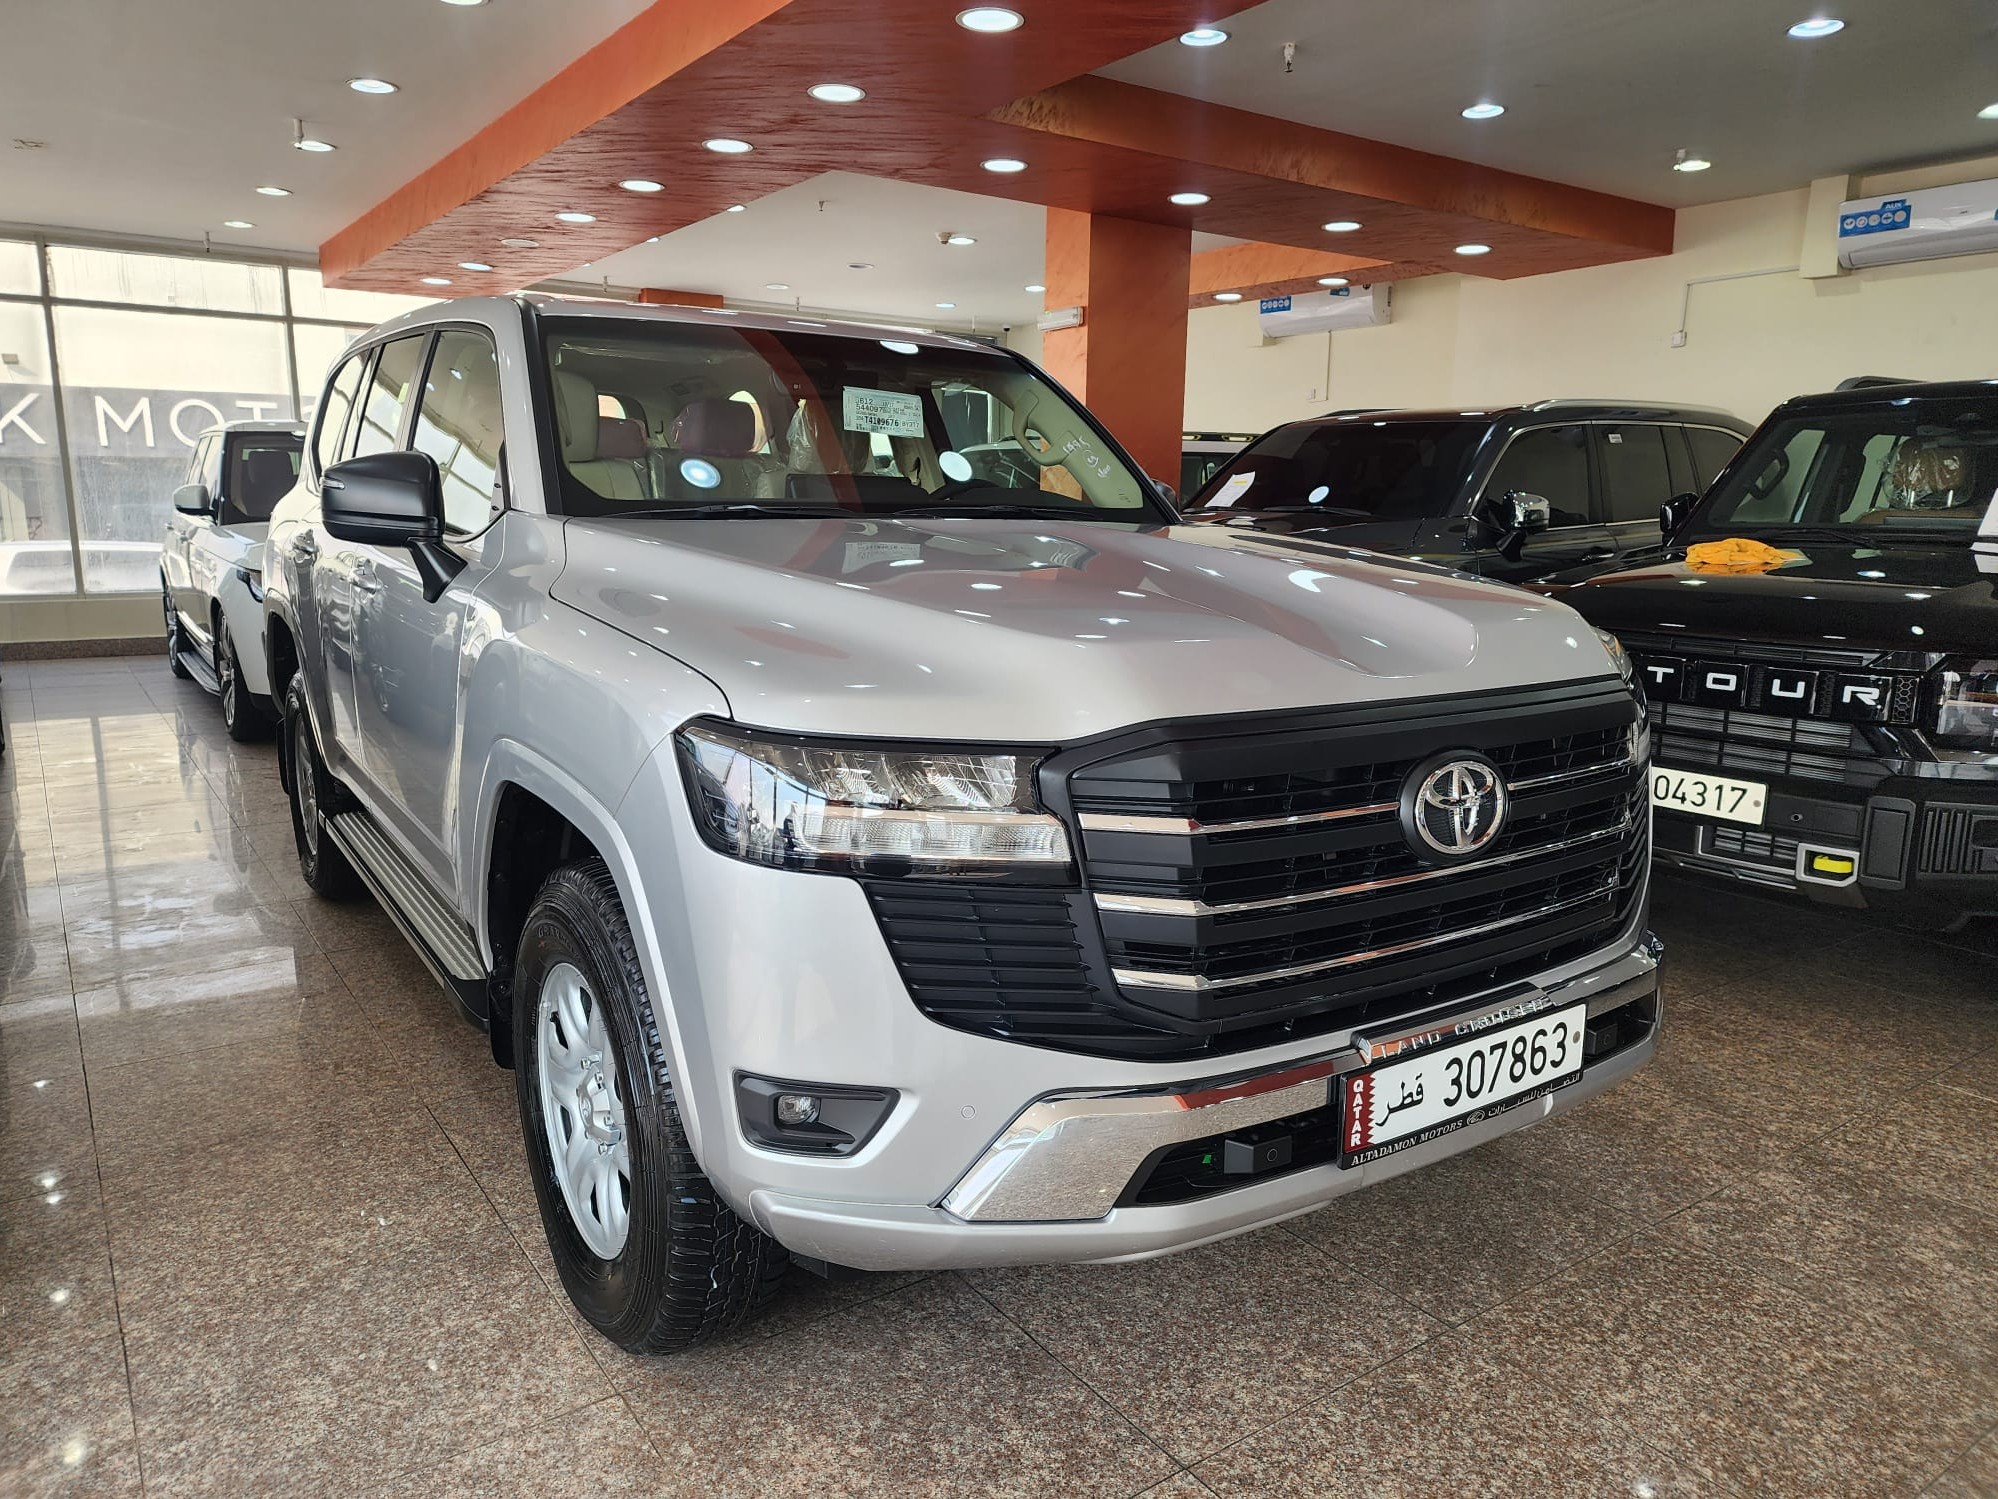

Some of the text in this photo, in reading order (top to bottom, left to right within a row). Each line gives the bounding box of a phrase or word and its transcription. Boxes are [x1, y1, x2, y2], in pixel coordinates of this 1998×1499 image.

[94, 395, 311, 448] MOT
[1647, 665, 1880, 706] TOUR
[1653, 775, 1748, 814] 04317
[1381, 1030, 1442, 1059] LAND
[1443, 1021, 1568, 1108] 307863
[1350, 1079, 1364, 1147] QATAR
[1375, 1073, 1424, 1127] قطر
[1351, 1119, 1463, 1166] ALTADAMON MOTORS
